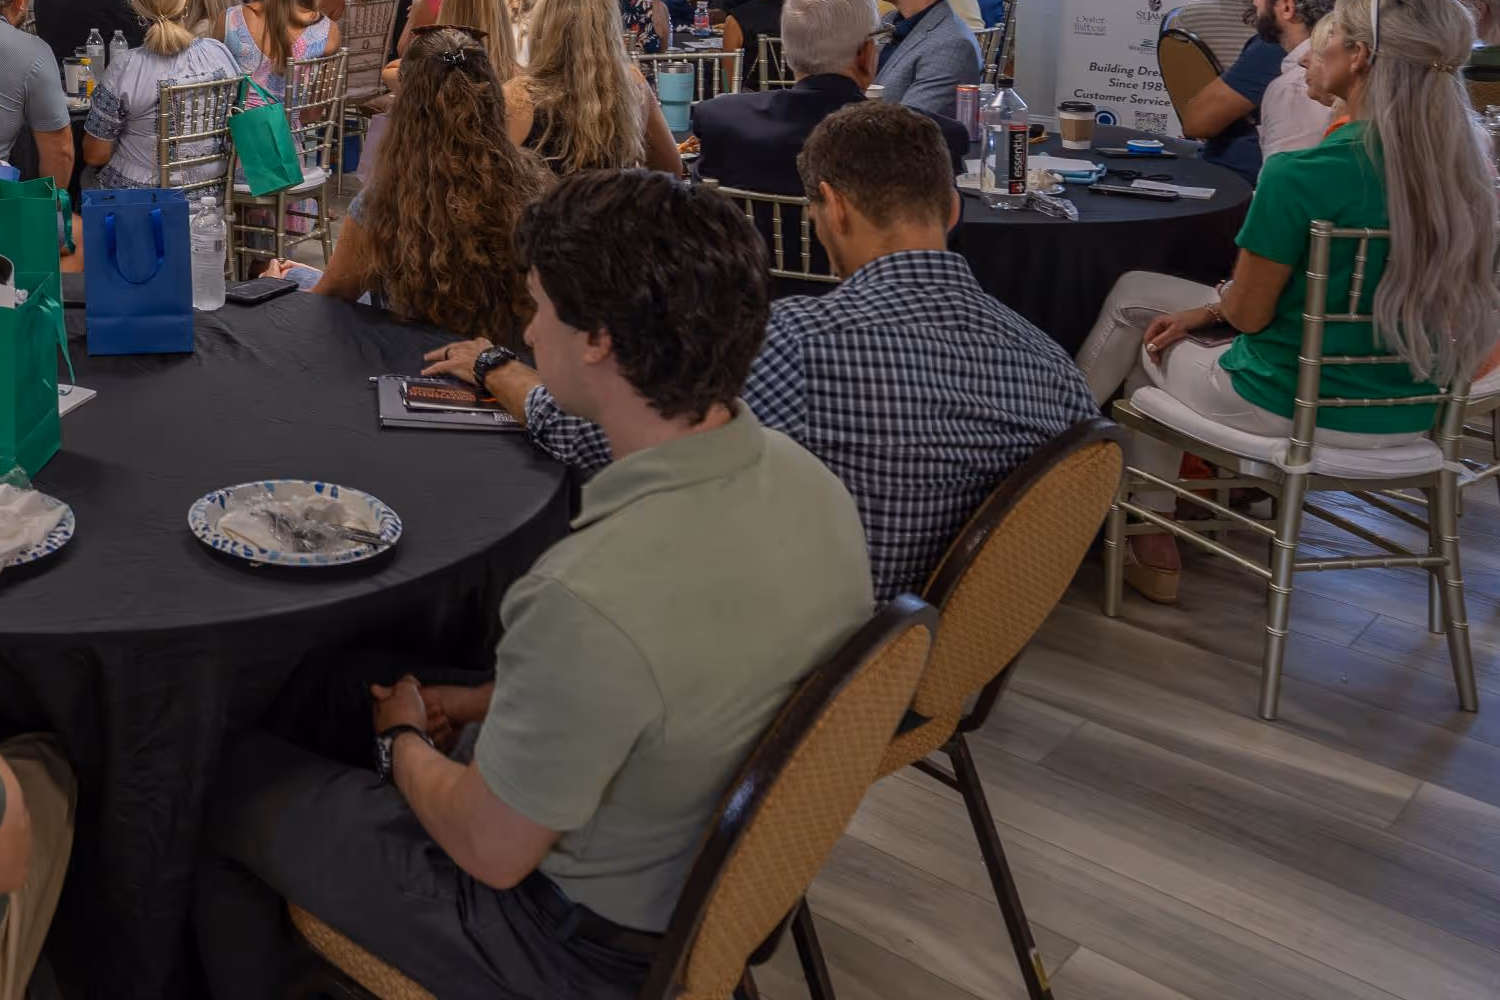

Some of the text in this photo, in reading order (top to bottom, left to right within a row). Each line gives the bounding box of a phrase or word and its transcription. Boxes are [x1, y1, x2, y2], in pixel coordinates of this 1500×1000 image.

[1089, 62, 1134, 78] Building
[1108, 78, 1139, 90] Since
[1074, 89, 1171, 106] Customer Service
[1012, 133, 1025, 178] essentia
